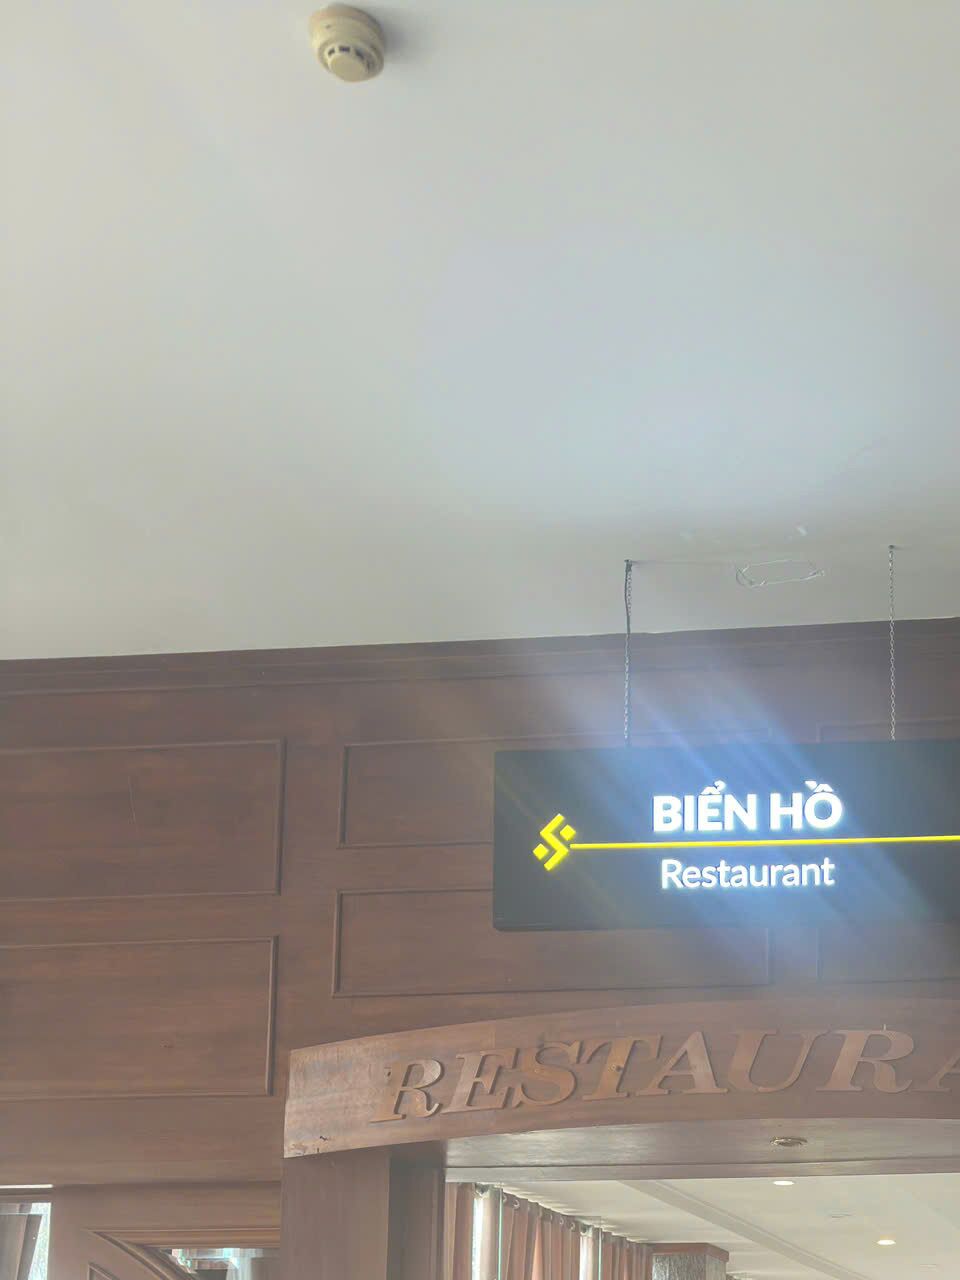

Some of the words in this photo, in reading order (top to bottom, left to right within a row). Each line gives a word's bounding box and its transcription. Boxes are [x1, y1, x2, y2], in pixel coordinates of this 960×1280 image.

[653, 780, 758, 832] BIỂN
[769, 780, 843, 830] HỒ
[661, 857, 836, 890] Restaurant
